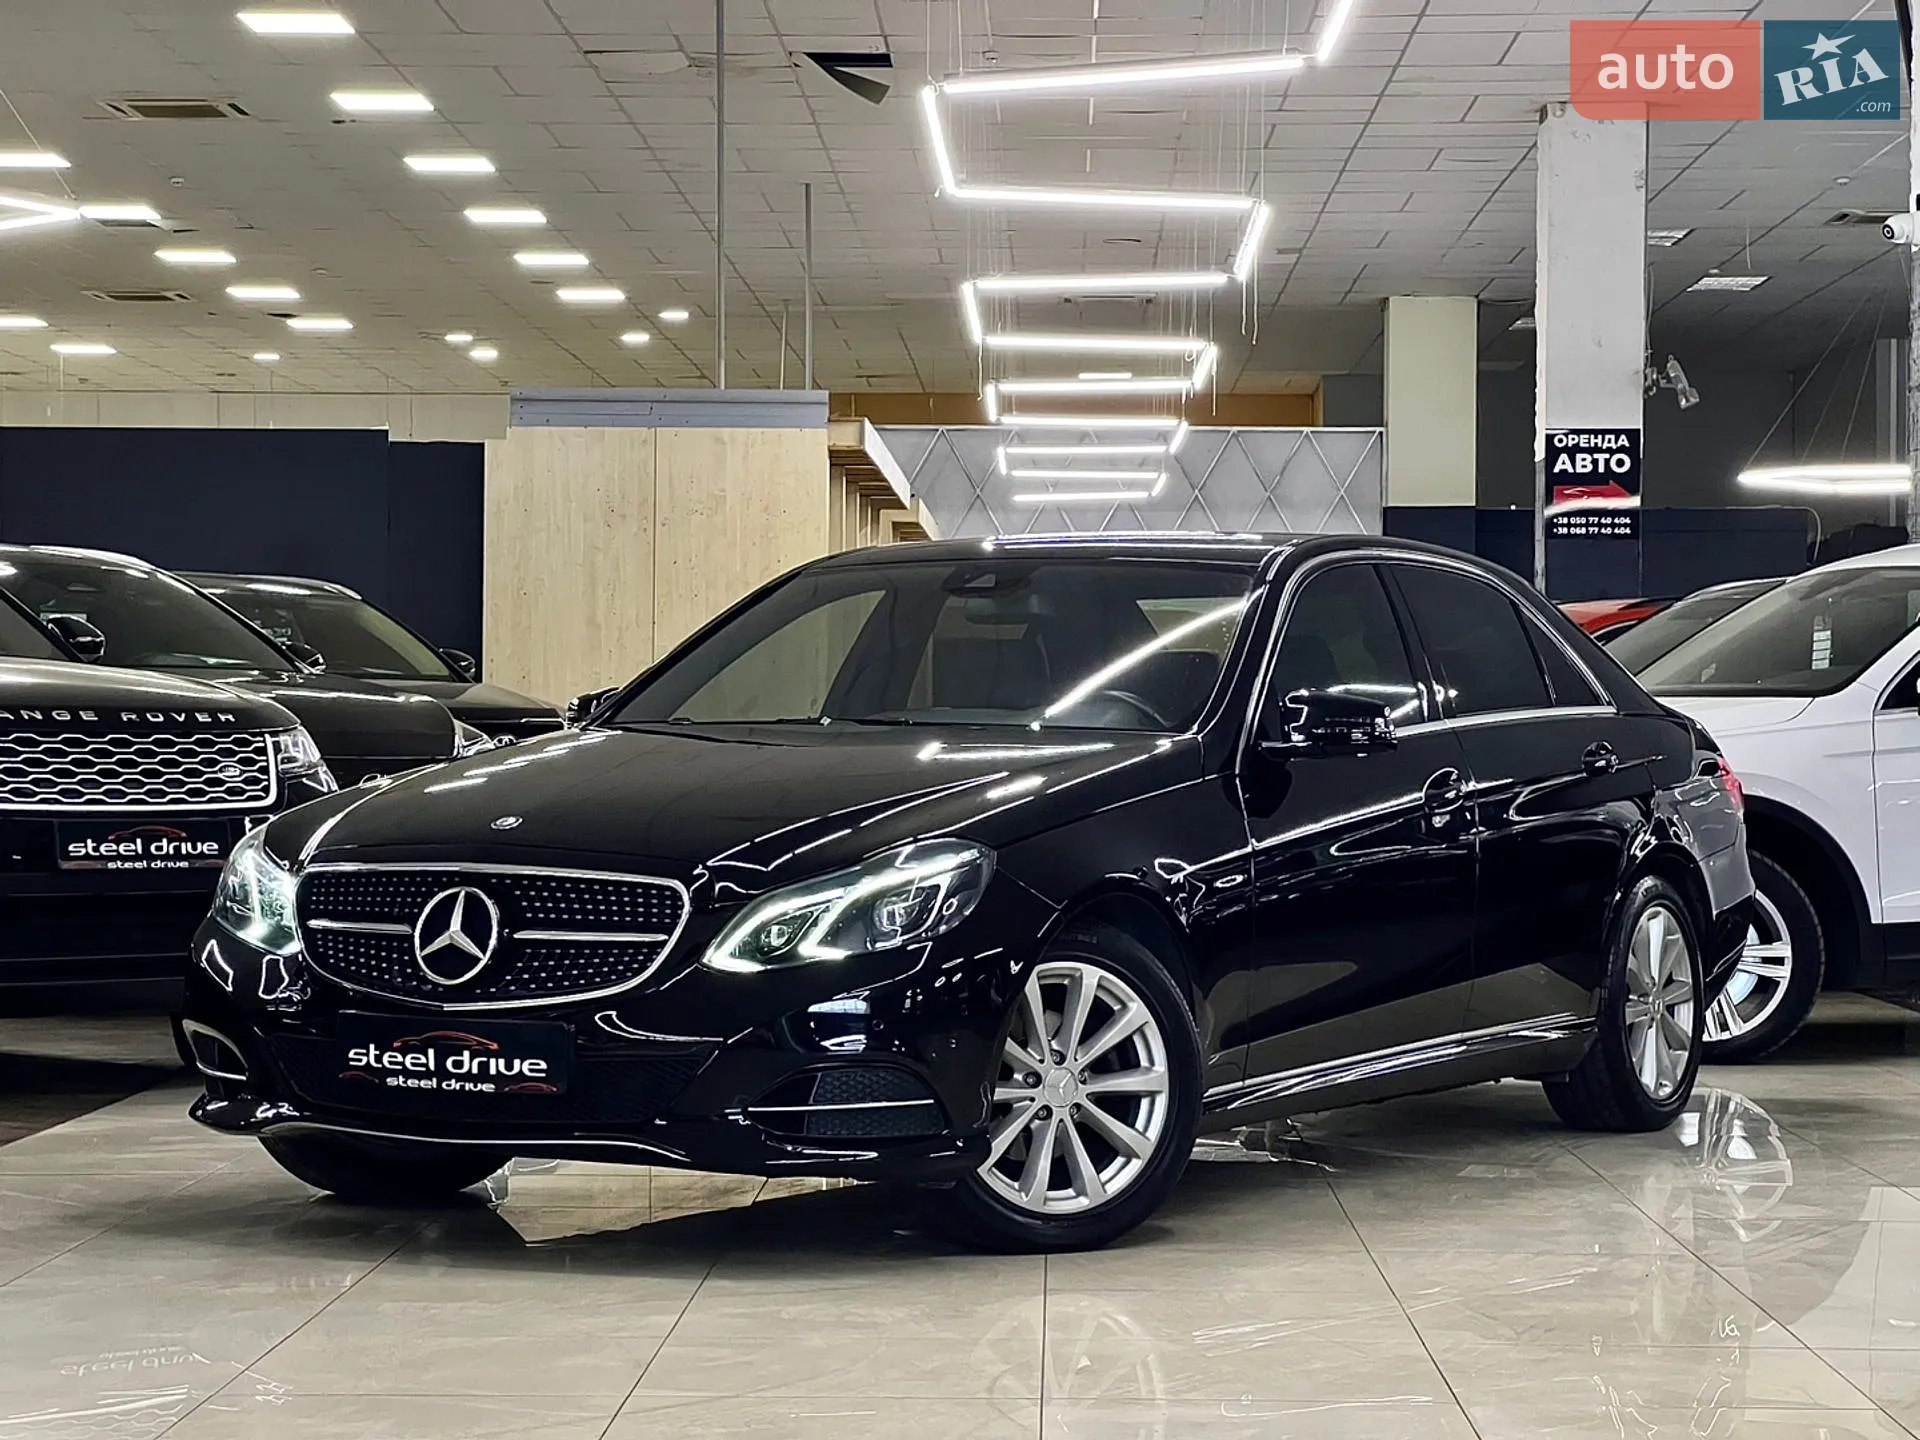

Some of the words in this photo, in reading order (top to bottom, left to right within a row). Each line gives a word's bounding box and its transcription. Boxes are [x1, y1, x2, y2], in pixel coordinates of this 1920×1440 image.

[1553, 434, 1630, 450] ОРЕНДА
[1552, 453, 1632, 474] АВТО
[0, 710, 99, 721] ANGE
[120, 711, 237, 722] ROVER
[68, 838, 143, 856] steel
[150, 838, 219, 856] drive
[107, 859, 148, 869] steel
[150, 859, 189, 869] drive
[348, 1043, 435, 1072] steel
[445, 1049, 548, 1077] drive
[386, 1075, 437, 1089] steel
[441, 1078, 496, 1092] drive
